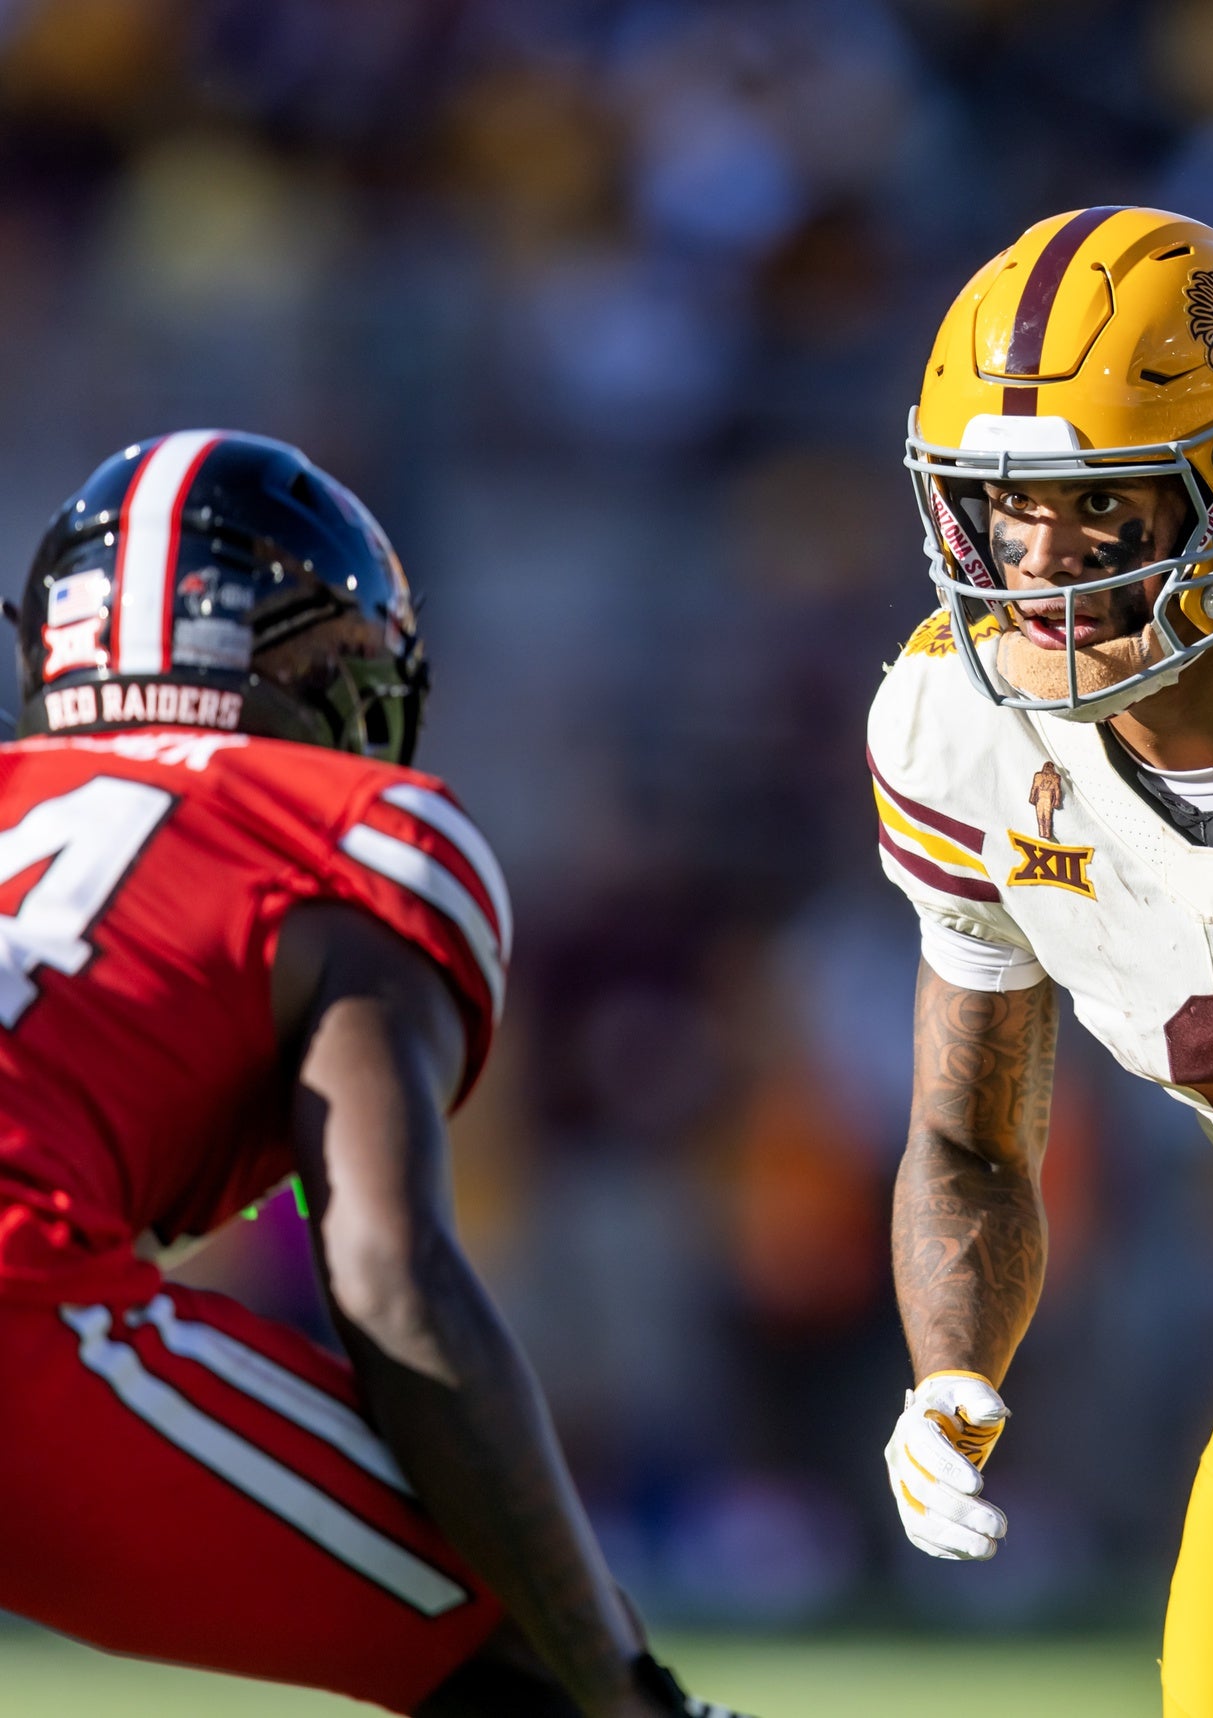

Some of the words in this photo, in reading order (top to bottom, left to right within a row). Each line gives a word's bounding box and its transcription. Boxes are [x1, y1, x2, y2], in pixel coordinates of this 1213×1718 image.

[932, 492, 973, 561] ARIZONA
[45, 685, 97, 730] RED
[101, 683, 242, 730] RAIDERS
[1013, 837, 1091, 893] XII
[0, 775, 173, 1031] 4
